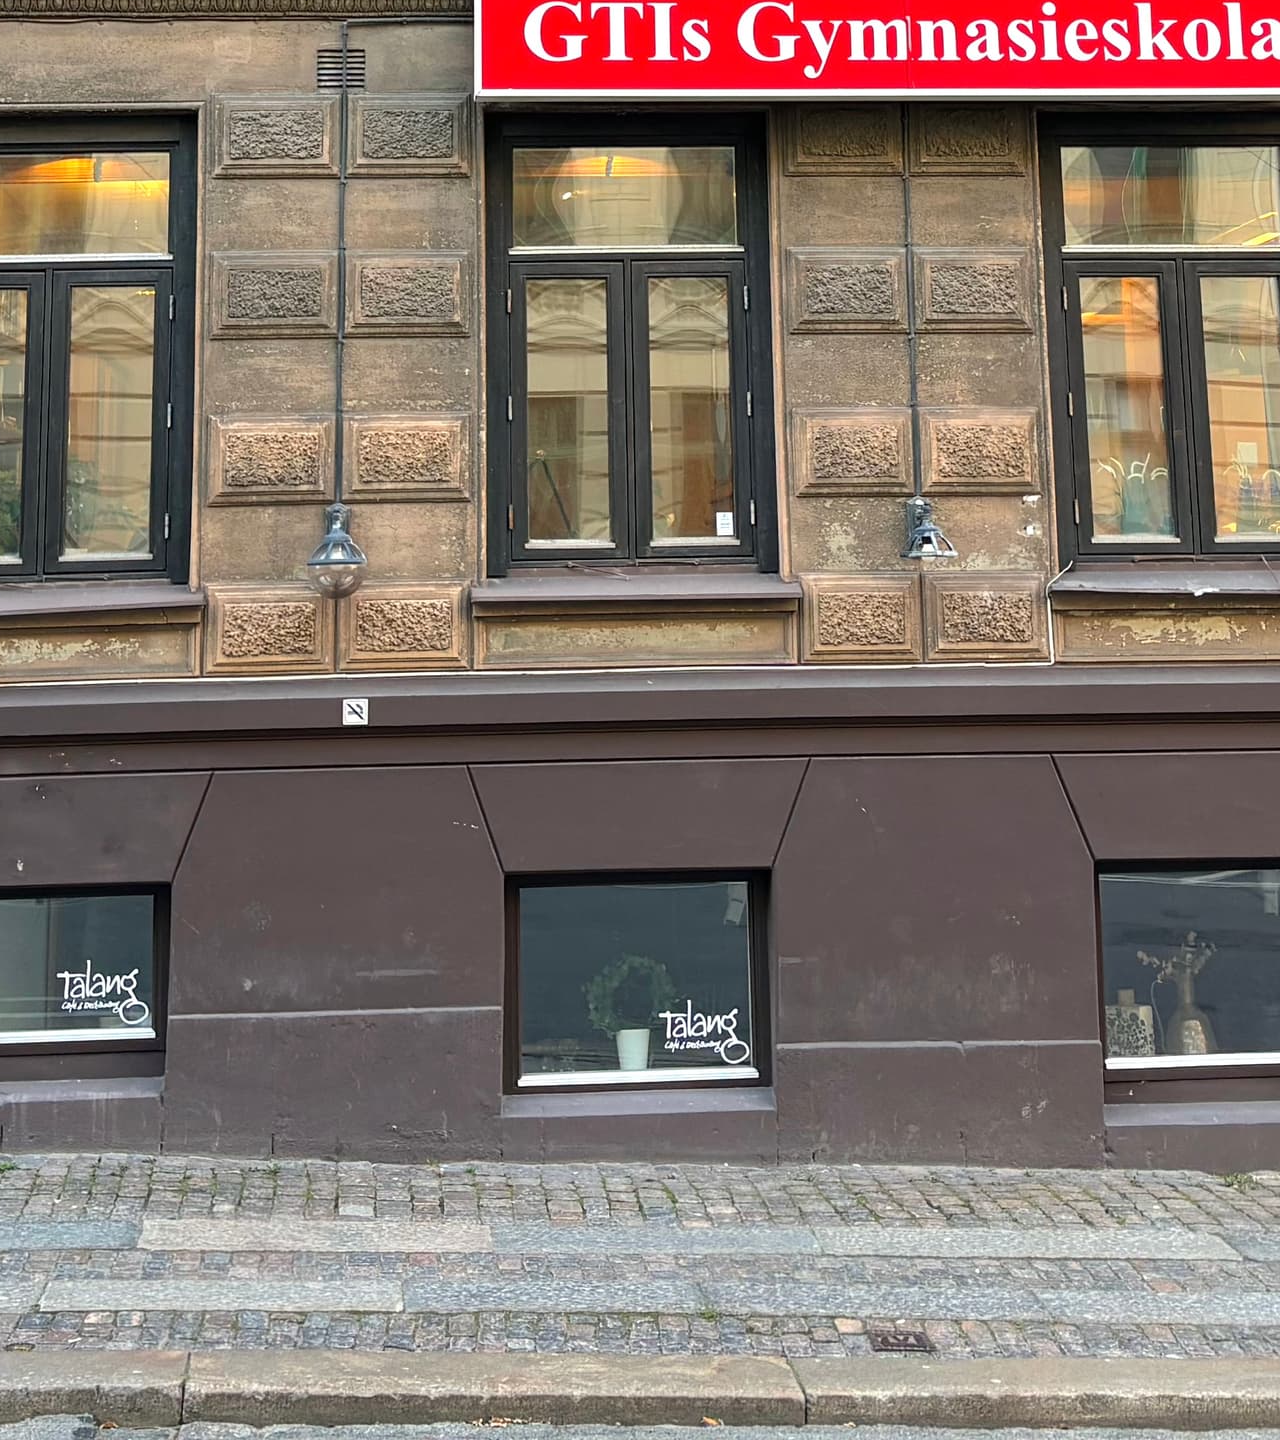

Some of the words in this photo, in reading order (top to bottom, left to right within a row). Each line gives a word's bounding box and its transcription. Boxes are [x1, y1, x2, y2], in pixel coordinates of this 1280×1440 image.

[522, 1, 712, 63] GTIs
[56, 959, 149, 1025] Talang
[658, 999, 750, 1064] Talang
